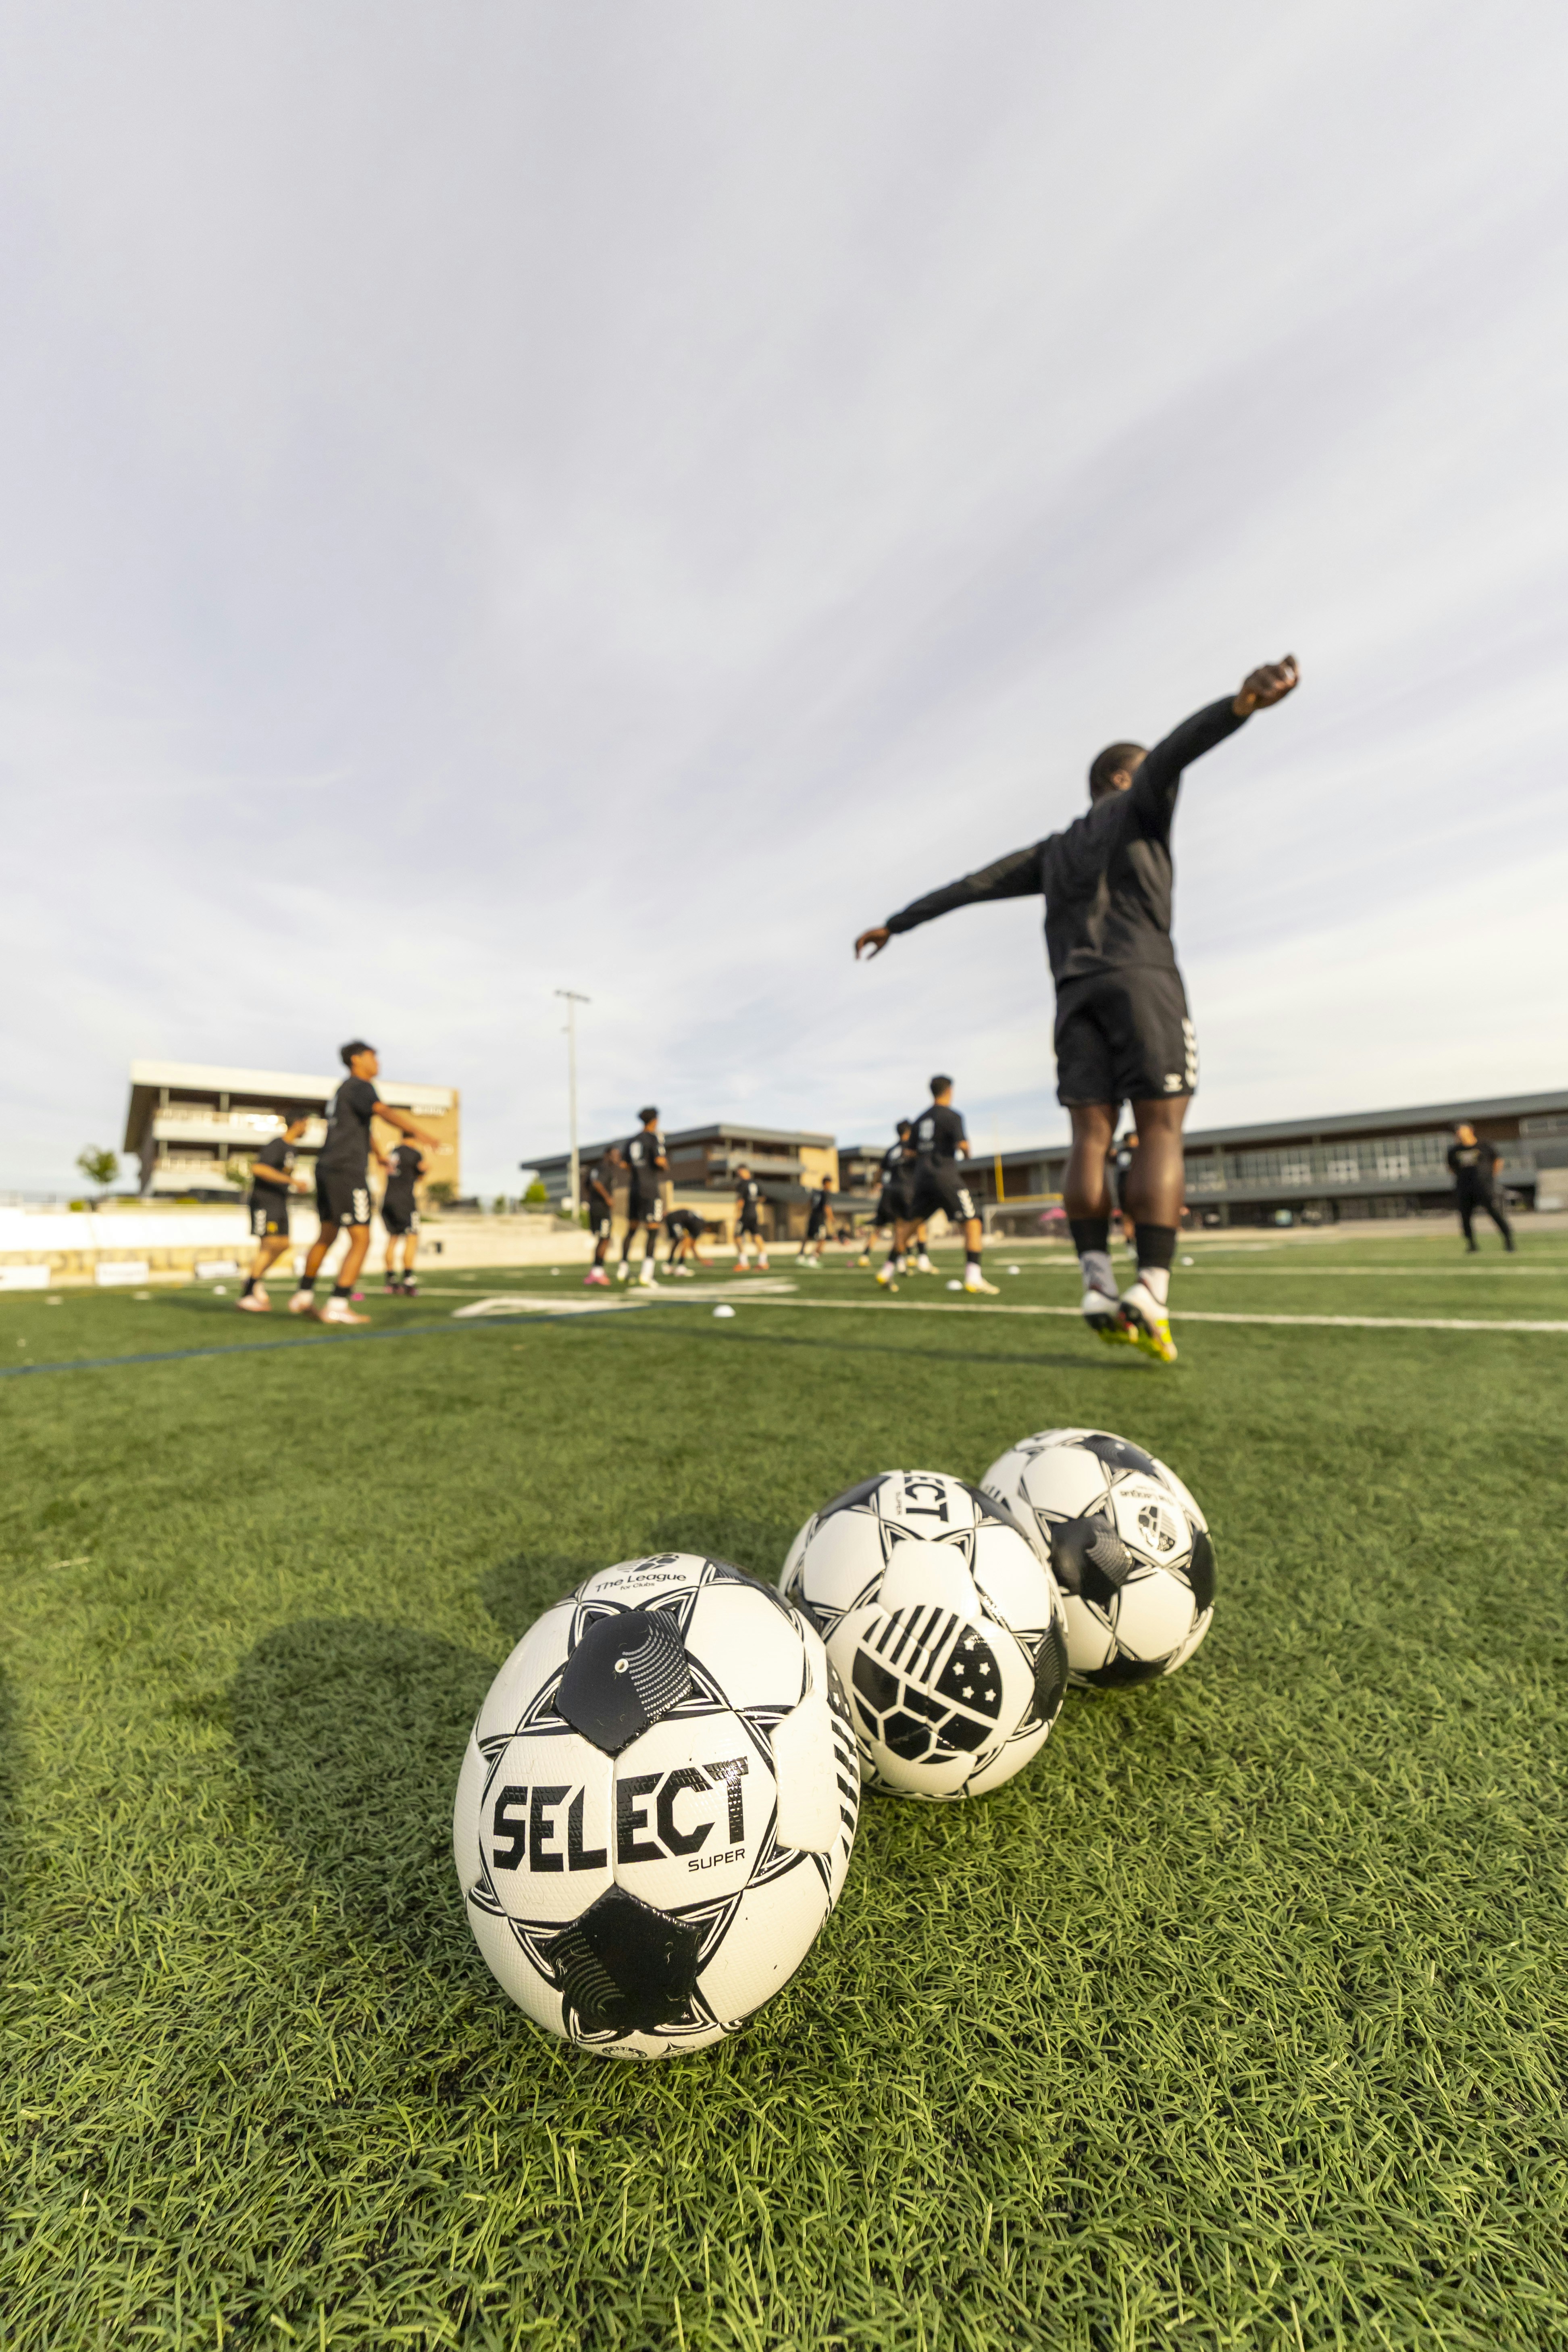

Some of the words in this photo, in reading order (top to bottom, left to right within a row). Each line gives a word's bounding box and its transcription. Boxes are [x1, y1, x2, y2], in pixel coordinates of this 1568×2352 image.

[903, 1470, 949, 1522] ECT
[596, 1579, 624, 1592] The
[627, 1574, 686, 1583] League
[493, 1756, 748, 1872] SELECT
[688, 1848, 745, 1872] SUPER
